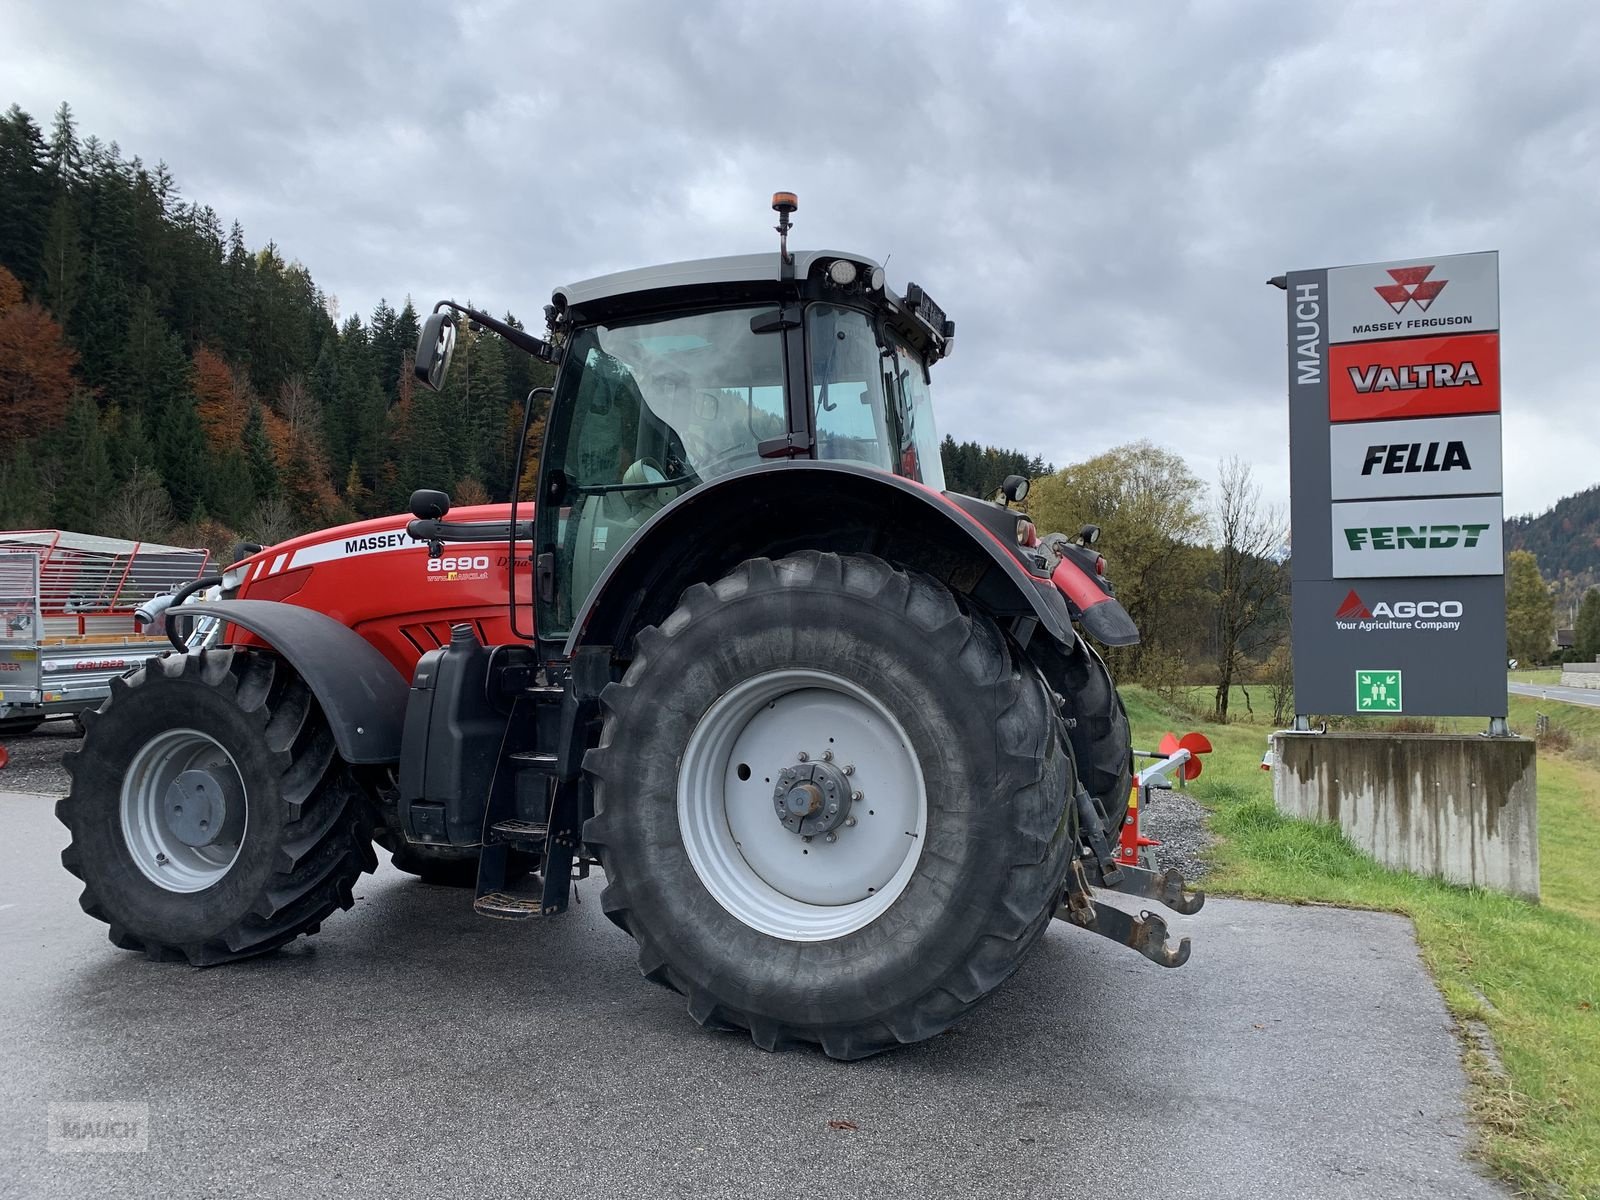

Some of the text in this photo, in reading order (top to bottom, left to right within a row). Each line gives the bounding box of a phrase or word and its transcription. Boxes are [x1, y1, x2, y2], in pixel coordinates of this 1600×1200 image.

[1296, 283, 1321, 385] MAUCH
[1352, 315, 1473, 334] MASSEY FERGUSON
[1347, 361, 1482, 394] VALTRA
[1361, 440, 1472, 475] FELLA
[345, 533, 406, 553] MASSEY
[1343, 524, 1490, 551] FENDT
[427, 556, 489, 571] 8690
[1371, 601, 1463, 618] AGCO
[1336, 620, 1460, 632] Your Agriculture Company
